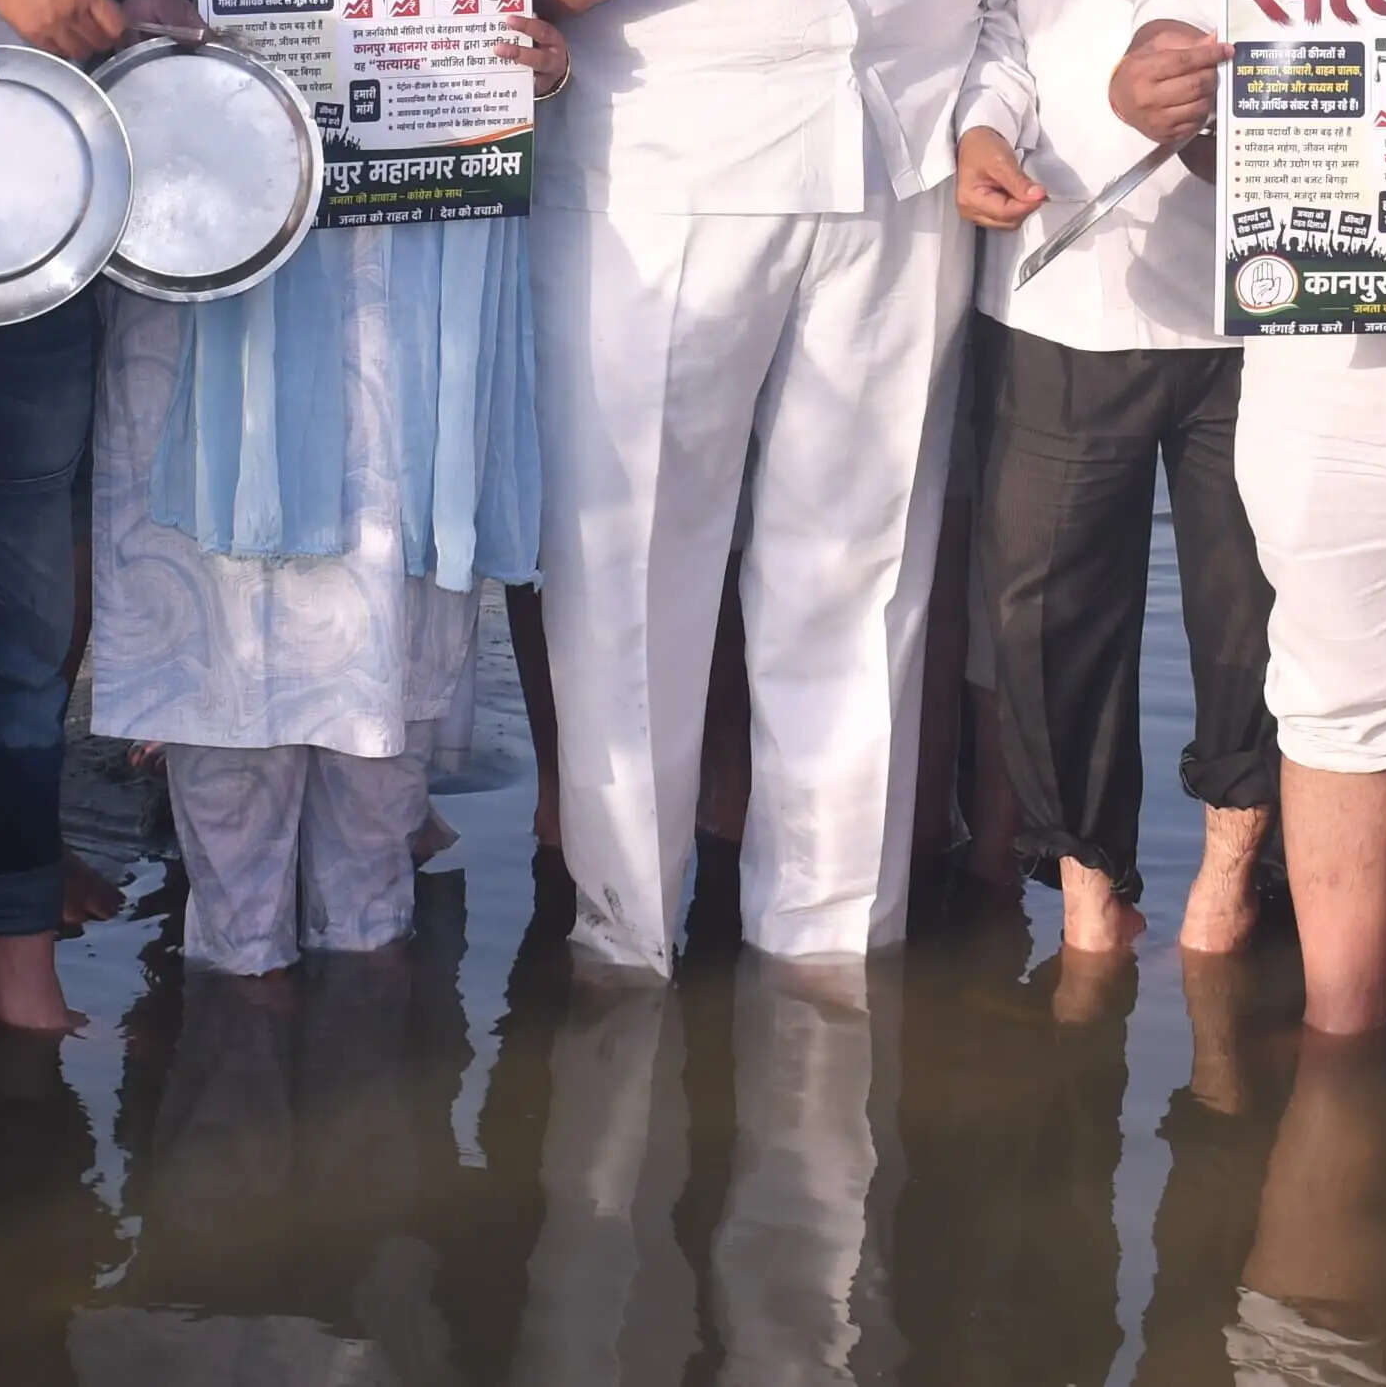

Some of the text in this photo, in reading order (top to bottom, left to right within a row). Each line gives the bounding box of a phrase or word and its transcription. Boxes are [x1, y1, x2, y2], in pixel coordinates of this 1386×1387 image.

[368, 146, 523, 184] महानगर कांग्रेस
[1353, 304, 1381, 313] जनता
